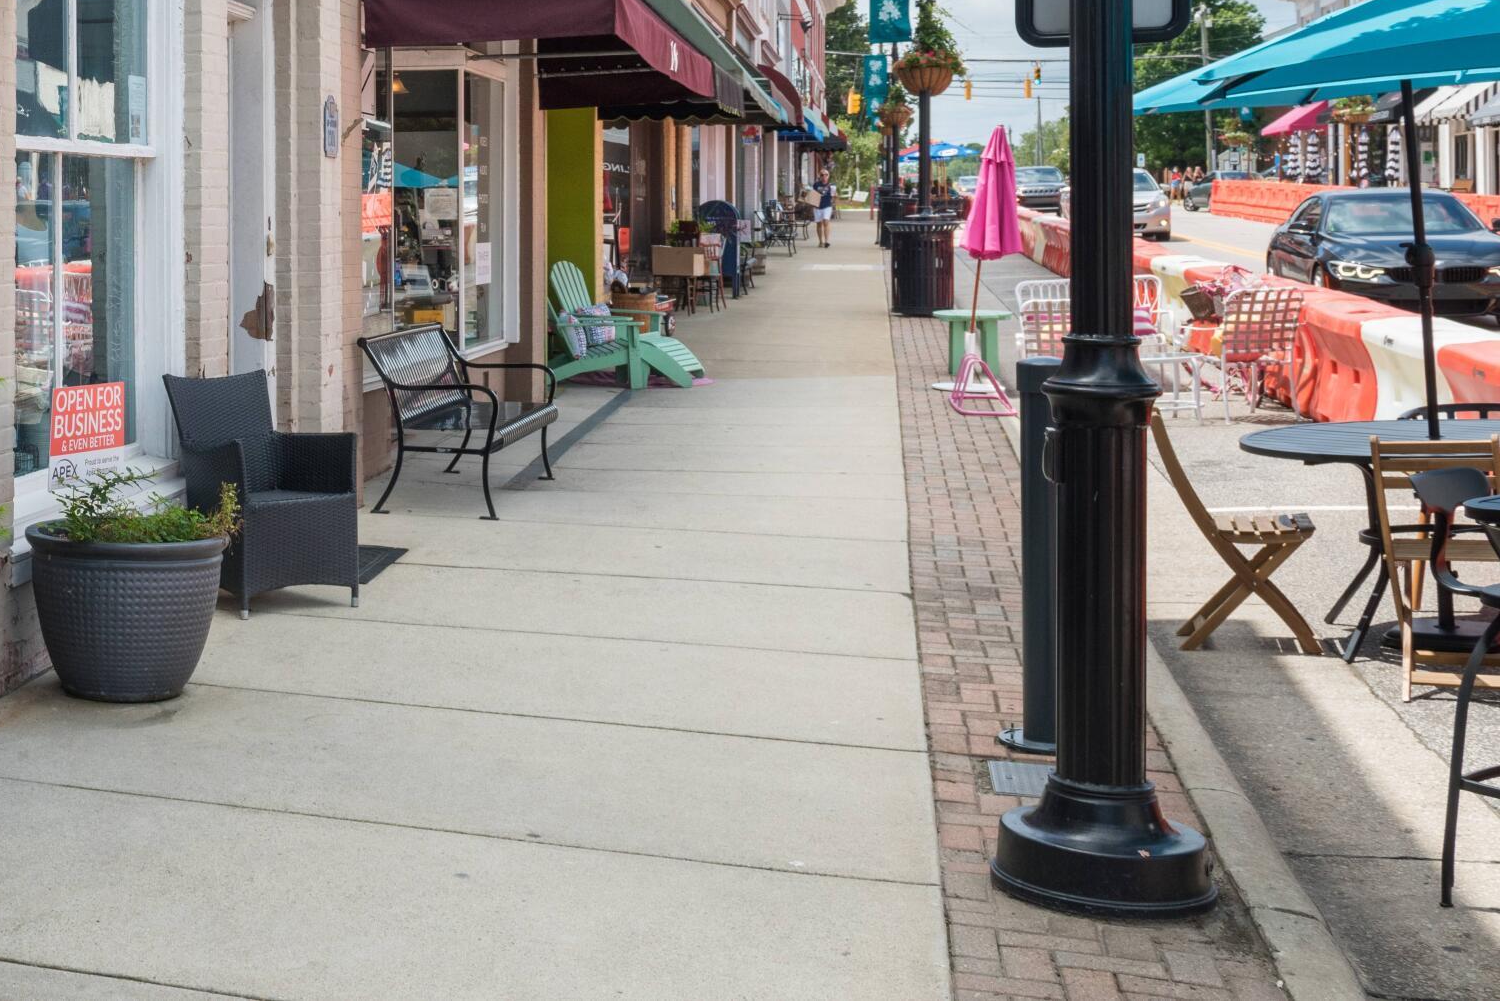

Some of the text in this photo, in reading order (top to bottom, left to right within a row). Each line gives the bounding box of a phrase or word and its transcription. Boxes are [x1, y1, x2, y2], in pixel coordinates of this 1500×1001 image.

[56, 385, 122, 413] OPEN FOR
[54, 408, 122, 439] BUSINESS
[61, 433, 115, 452] & EVEN BETTER
[52, 463, 78, 480] APEX
